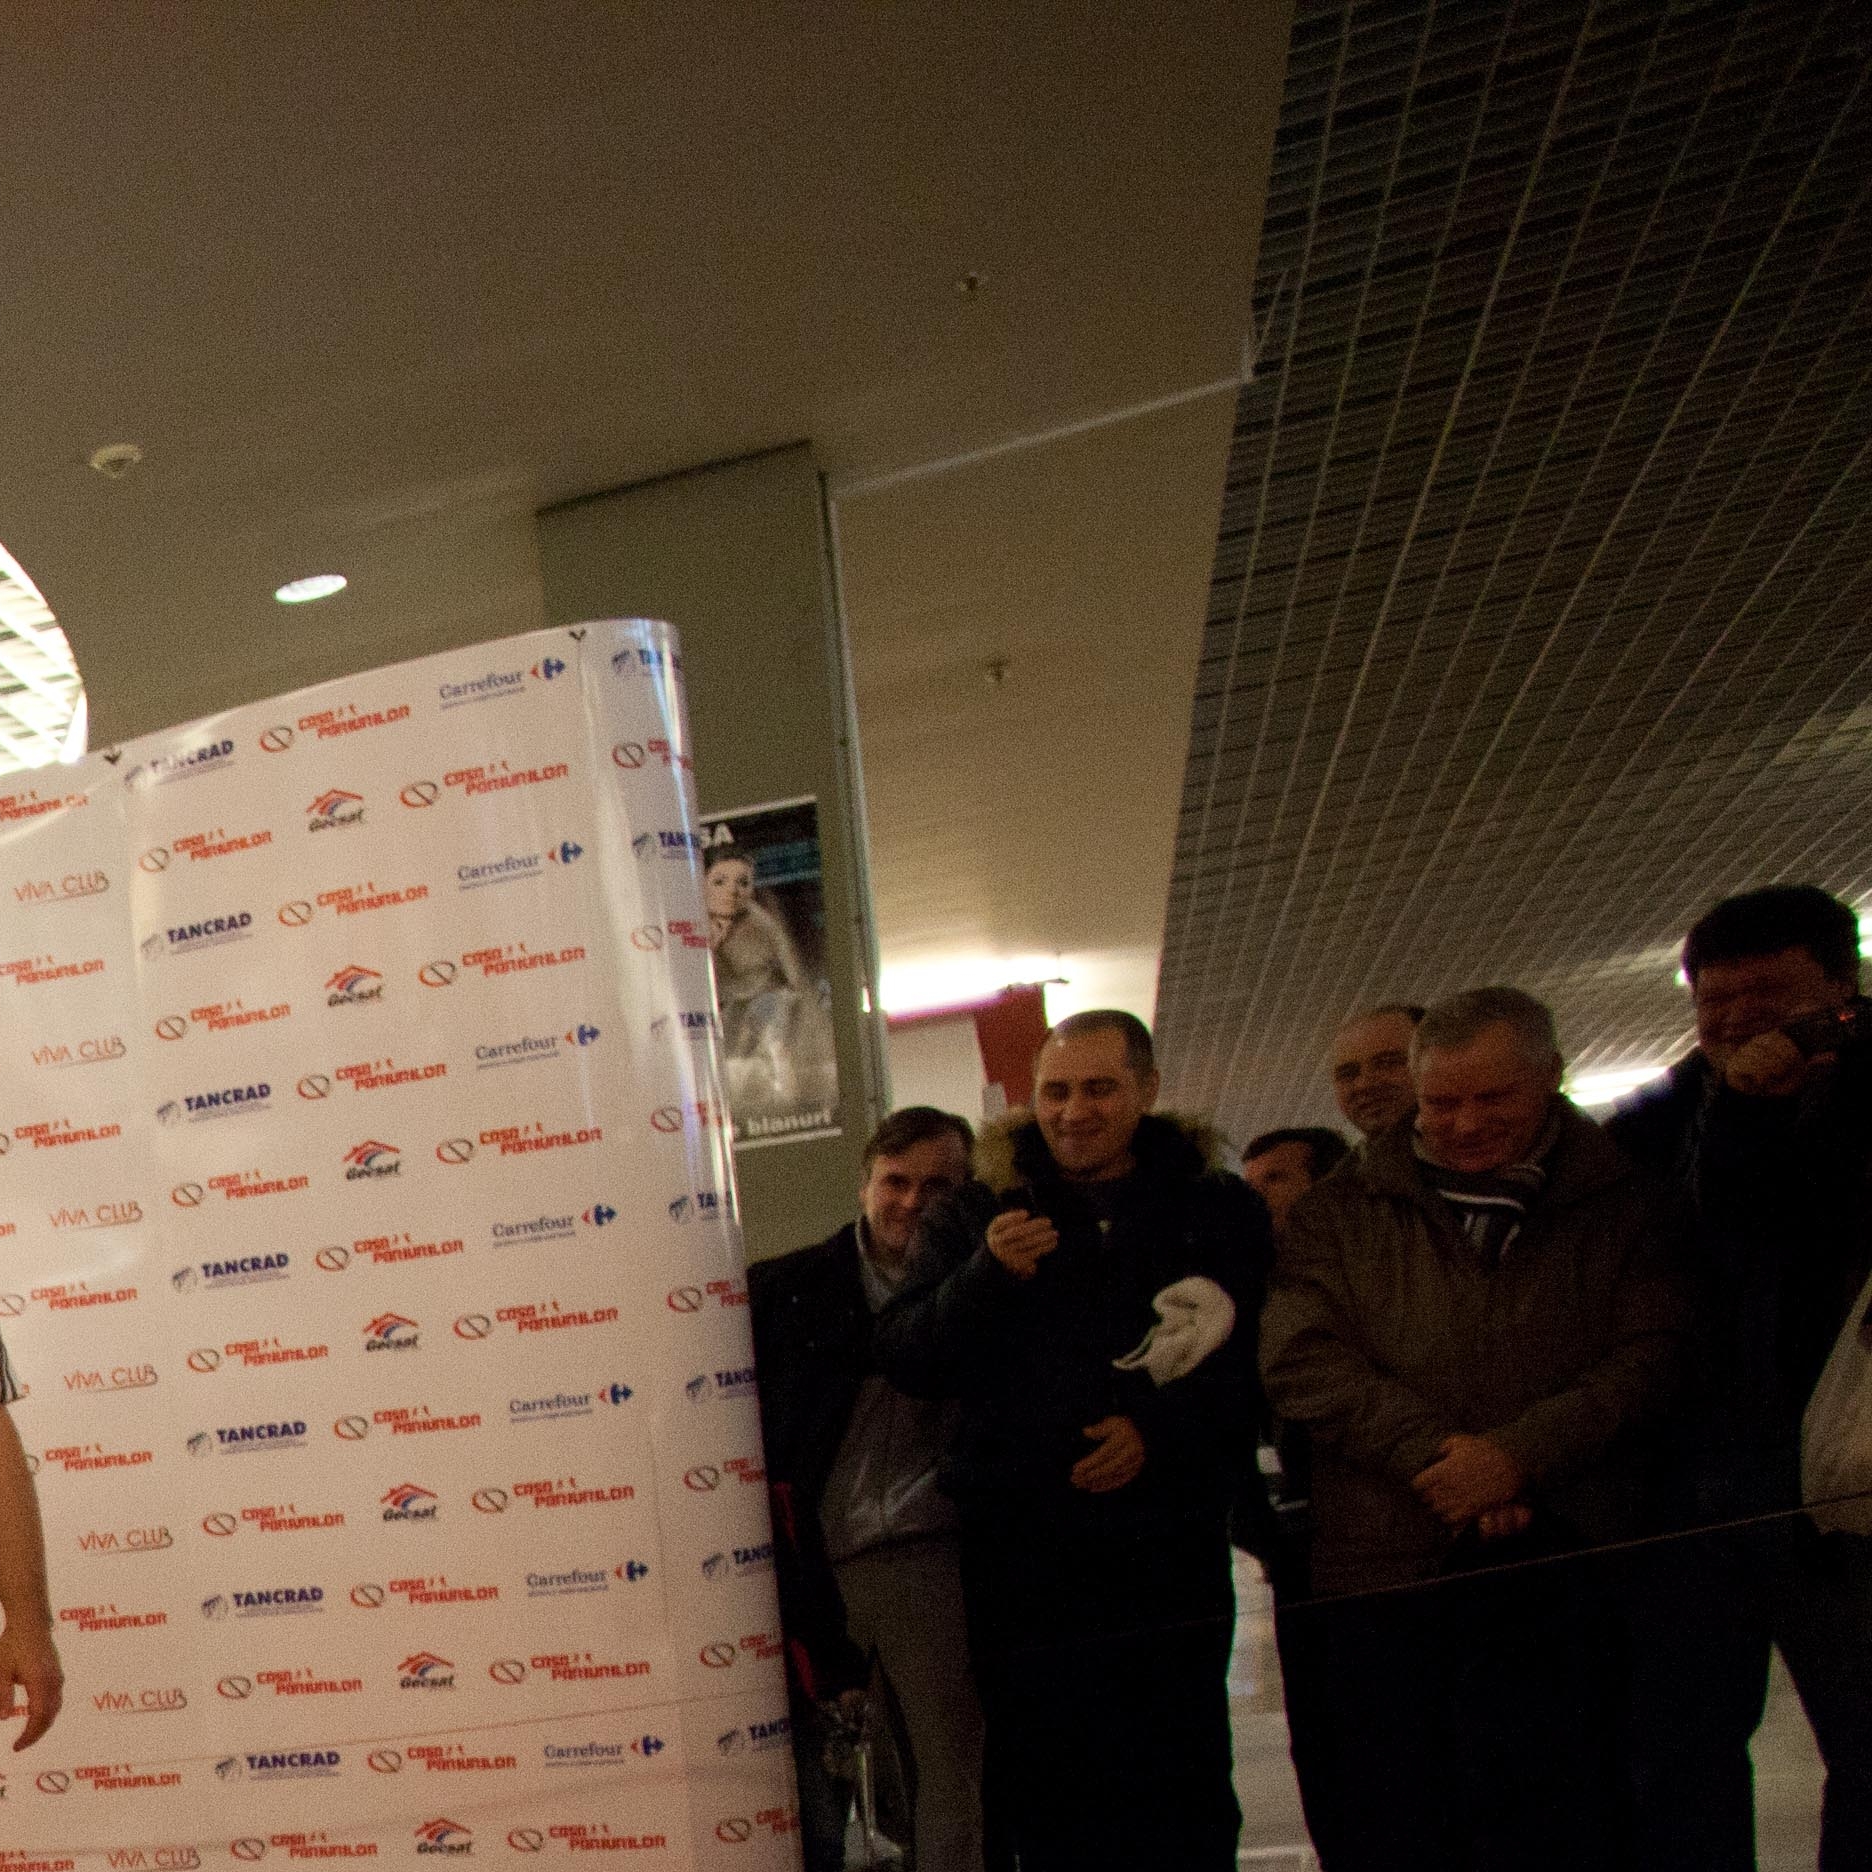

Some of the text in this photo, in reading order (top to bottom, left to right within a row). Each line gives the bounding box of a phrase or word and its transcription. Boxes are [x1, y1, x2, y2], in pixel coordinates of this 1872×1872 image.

[439, 672, 522, 698] Carrefour
[457, 854, 538, 880] Carrefour
[61, 870, 109, 896] CLUB
[168, 913, 251, 942] TANCRAD
[79, 1035, 127, 1060] CLUB
[476, 1037, 556, 1059] Carrefour
[185, 1084, 270, 1110] TANCRAD
[96, 1200, 143, 1223] CLUB
[493, 1215, 573, 1237] Carrefour
[202, 1253, 288, 1278] TANCRAD
[111, 1364, 158, 1386] CLUB
[510, 1393, 590, 1414] Carrefour
[218, 1421, 306, 1443] TANCRAD
[126, 1526, 173, 1549] CLUB
[526, 1569, 607, 1587] Carrefour
[233, 1587, 324, 1606] TANCRAD
[141, 1688, 187, 1709] CLUB
[247, 1751, 340, 1770] TANCRAD
[543, 1742, 621, 1758] Carrefour
[155, 1847, 201, 1869] CLUB
